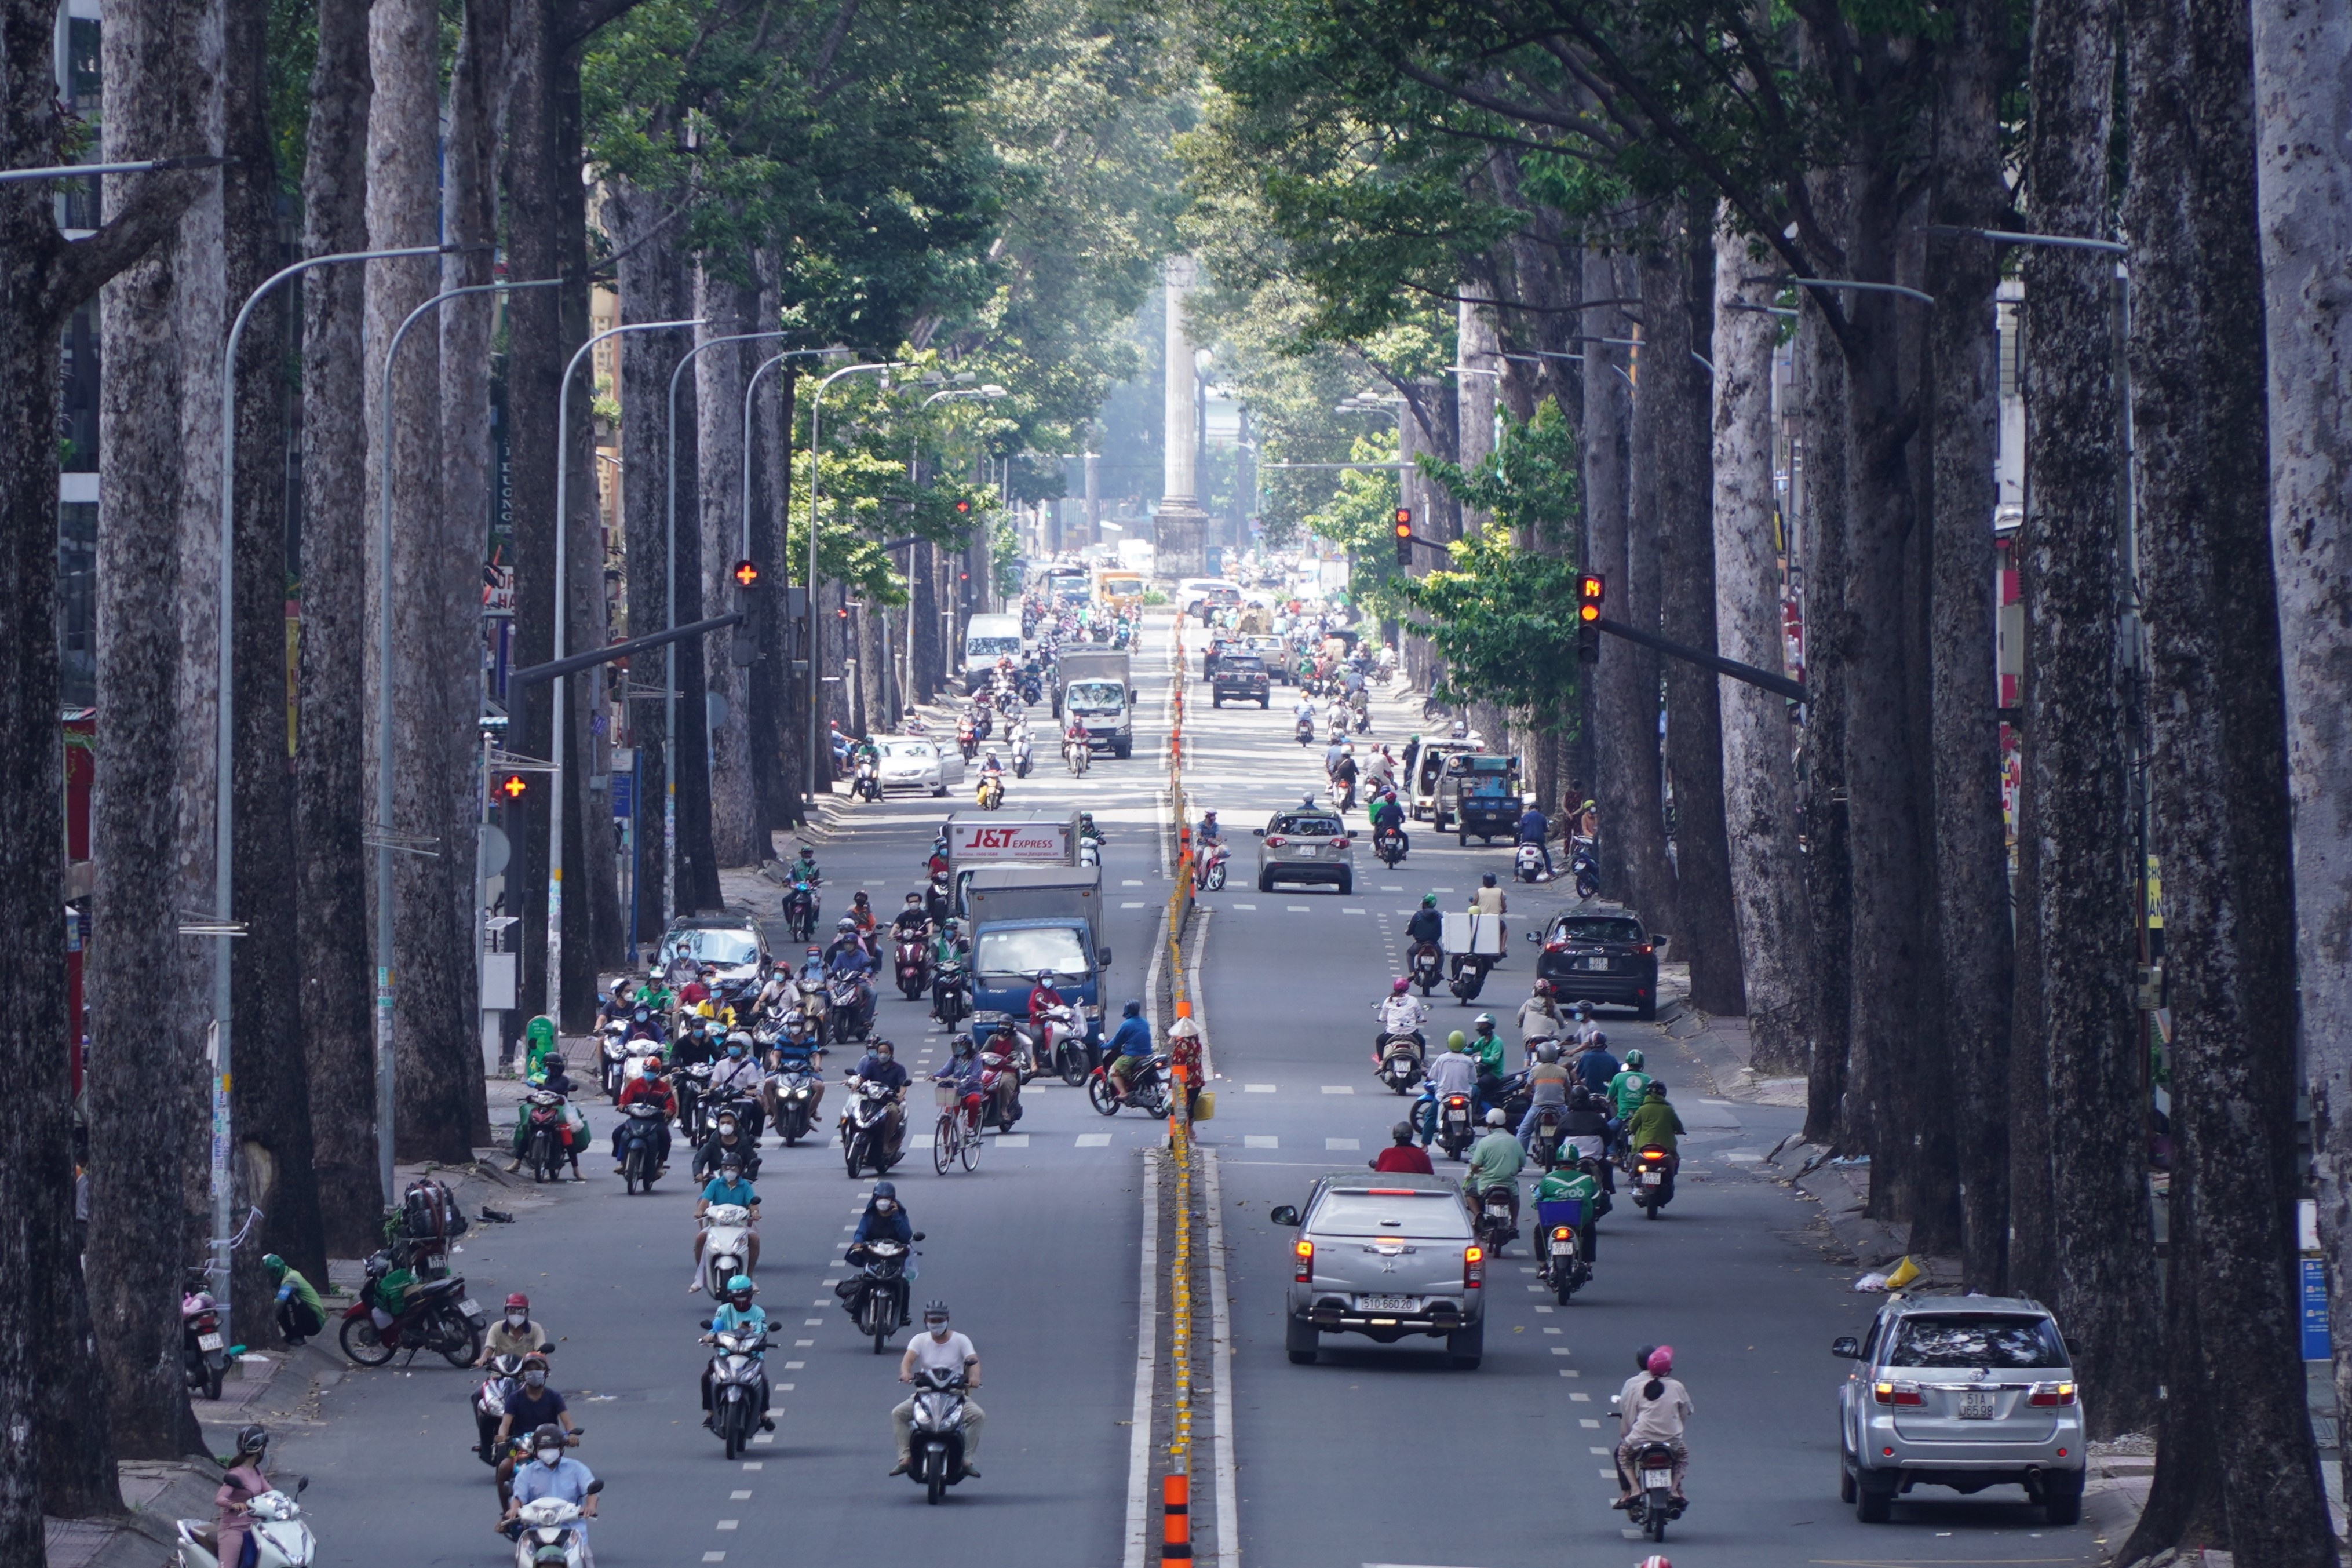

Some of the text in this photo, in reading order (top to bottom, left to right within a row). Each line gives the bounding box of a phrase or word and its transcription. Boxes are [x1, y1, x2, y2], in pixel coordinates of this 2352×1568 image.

[965, 829, 1053, 848] J&T EXPRESS
[1555, 1186, 1585, 1198] Grab
[1967, 1394, 1986, 1405] 51A
[11, 1426, 24, 1442] 15
